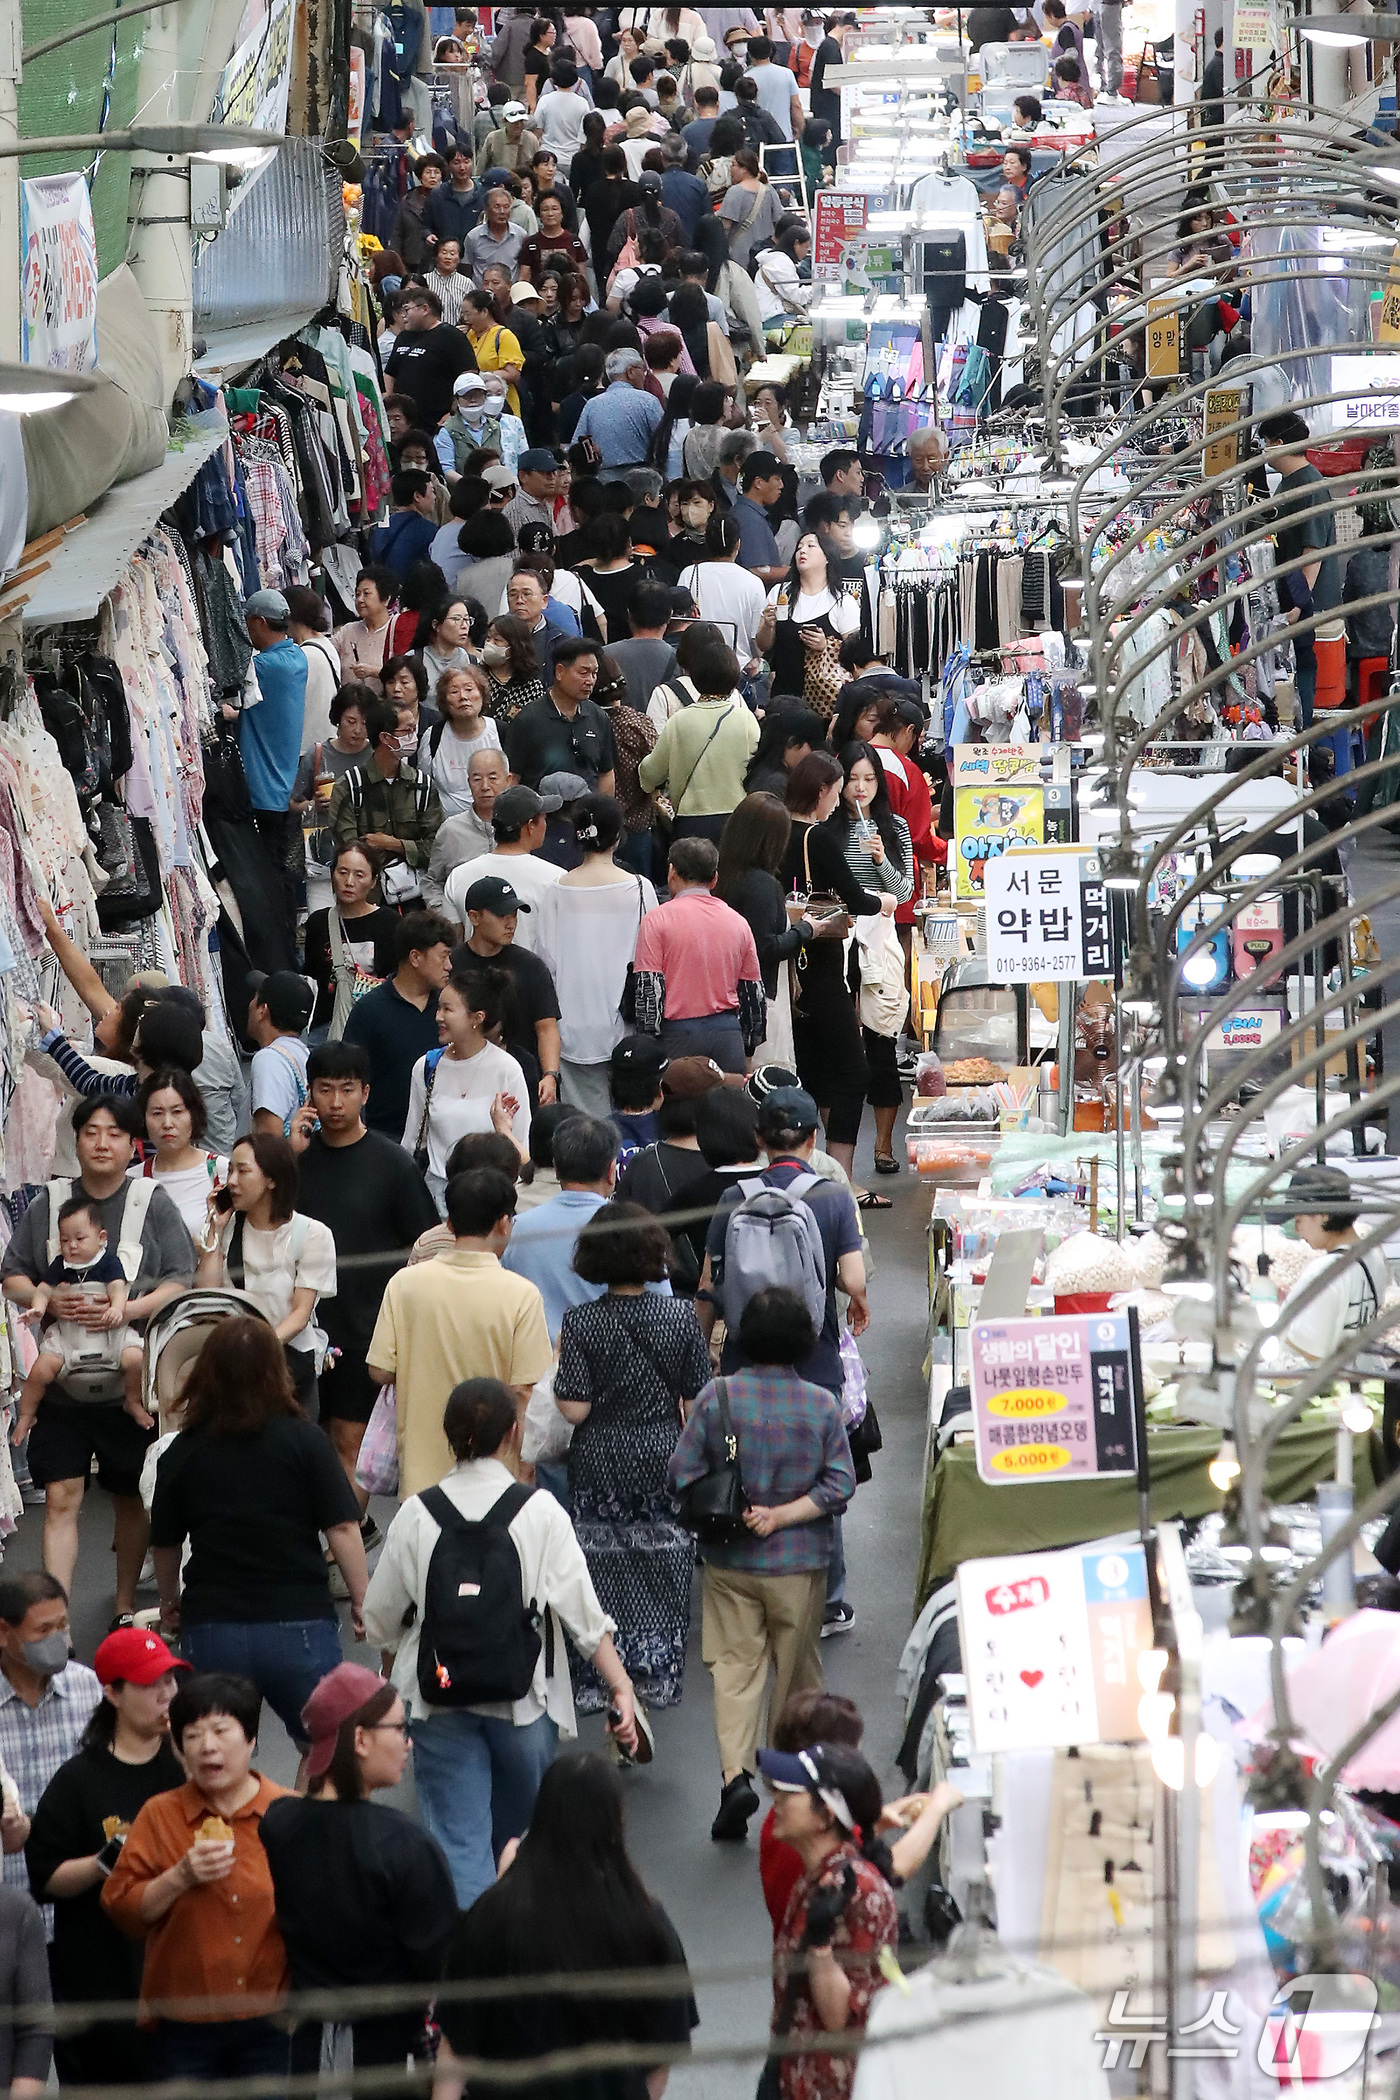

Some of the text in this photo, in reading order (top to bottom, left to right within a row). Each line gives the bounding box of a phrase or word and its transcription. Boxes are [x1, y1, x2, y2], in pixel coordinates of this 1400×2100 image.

[1153, 330, 1175, 348] 양말
[973, 747, 988, 756] 원조
[960, 759, 990, 774] 새벽
[1051, 791, 1058, 800] 3
[1090, 862, 1096, 871] 3
[1007, 870, 1062, 895] 서문
[997, 907, 1073, 943] 약밥
[1085, 886, 1110, 969] 먹거리
[997, 956, 1076, 972] 010-9364-2577
[1223, 1033, 1261, 1045] 2,000원
[980, 1332, 1082, 1364] 생활의 달인
